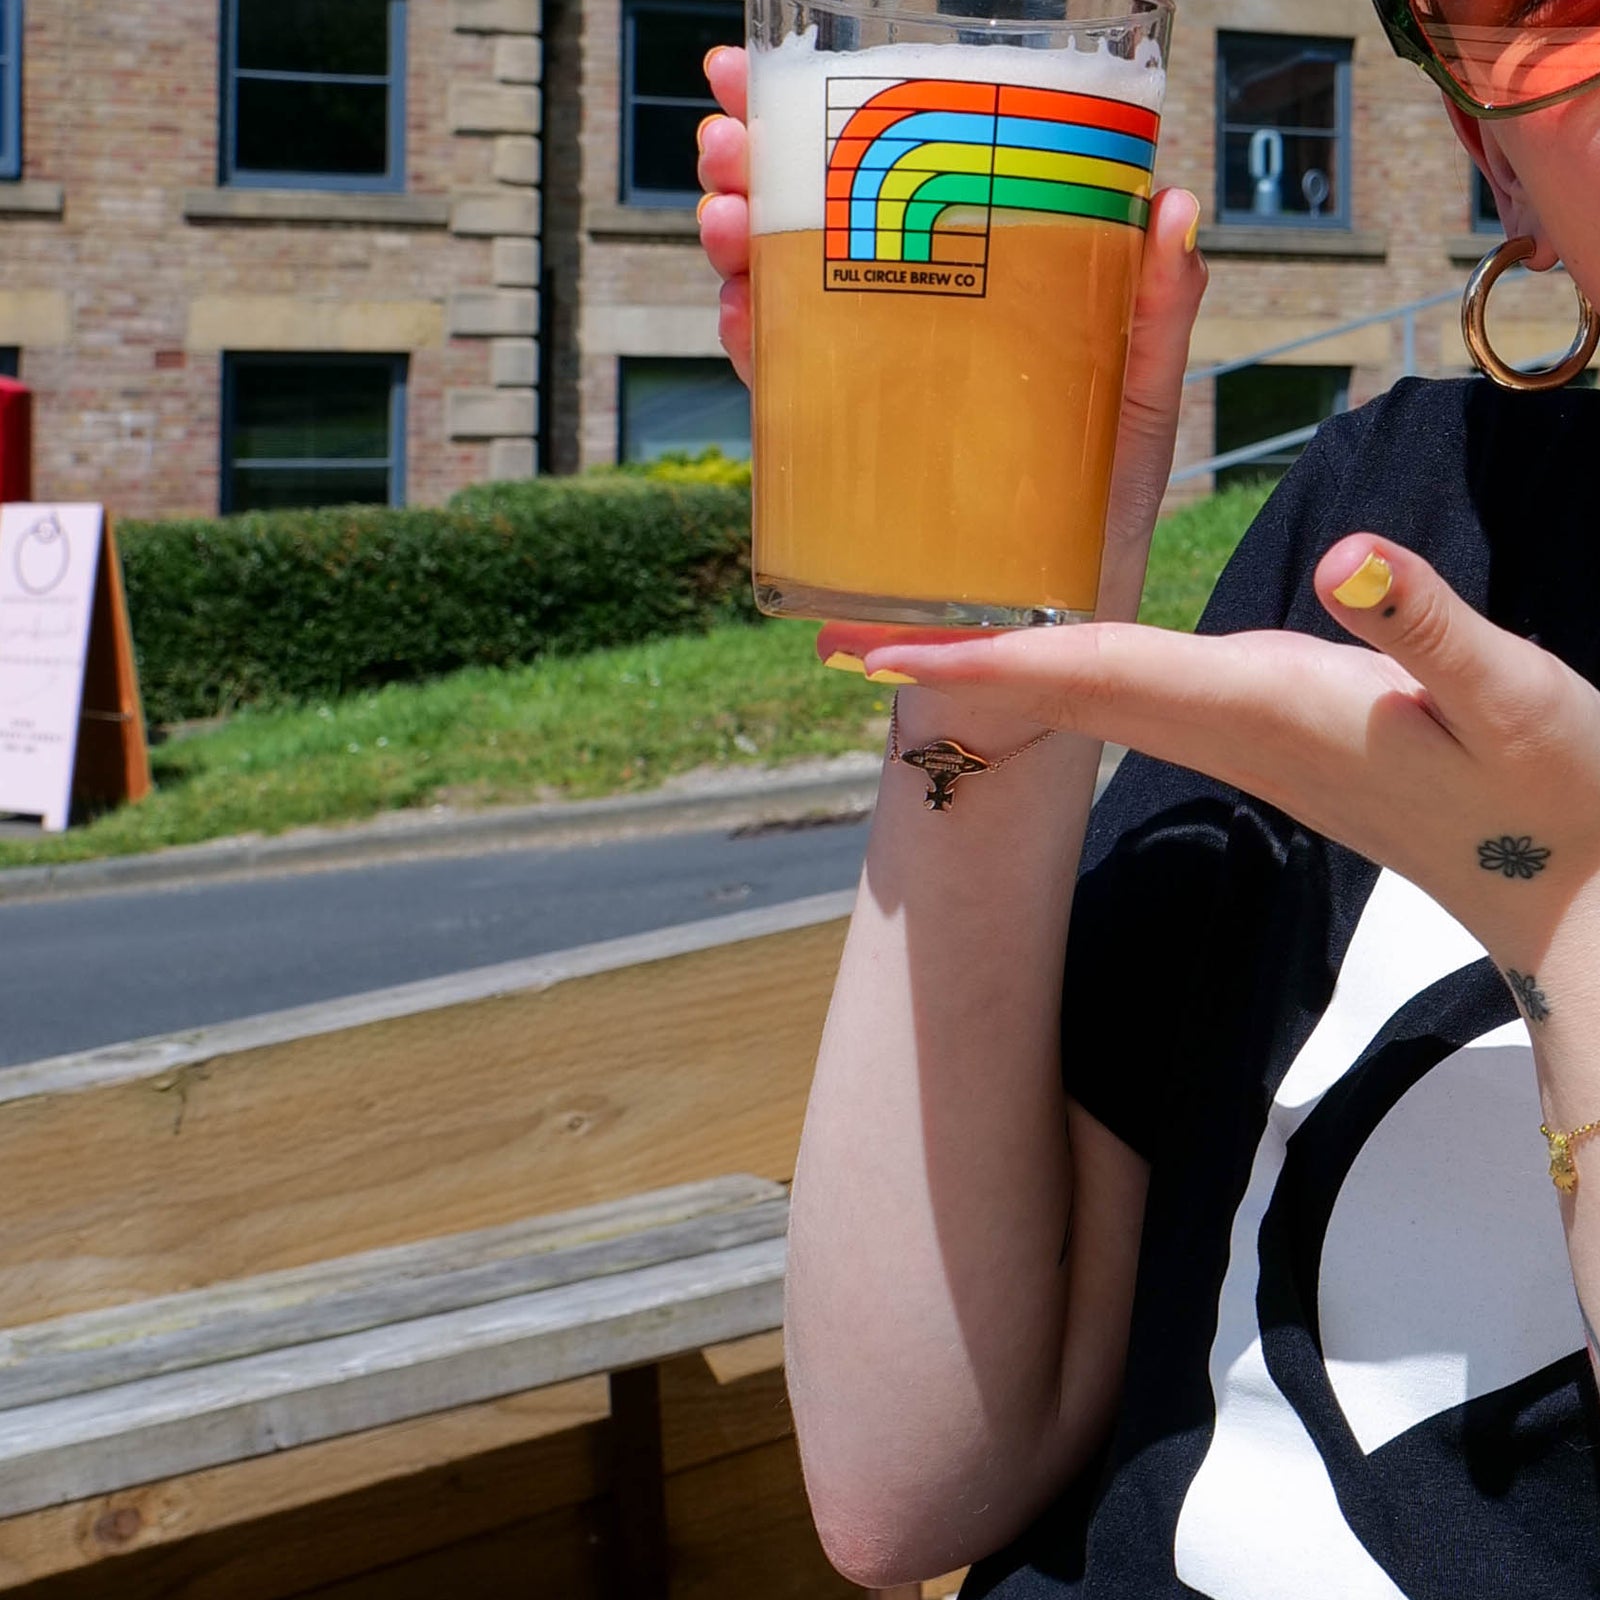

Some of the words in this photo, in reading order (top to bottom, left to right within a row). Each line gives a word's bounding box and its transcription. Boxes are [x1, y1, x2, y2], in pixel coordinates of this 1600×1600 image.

[833, 269, 861, 283] FULL
[864, 270, 907, 284] CIRCLE
[910, 272, 951, 286] BREW
[955, 273, 975, 287] CO
